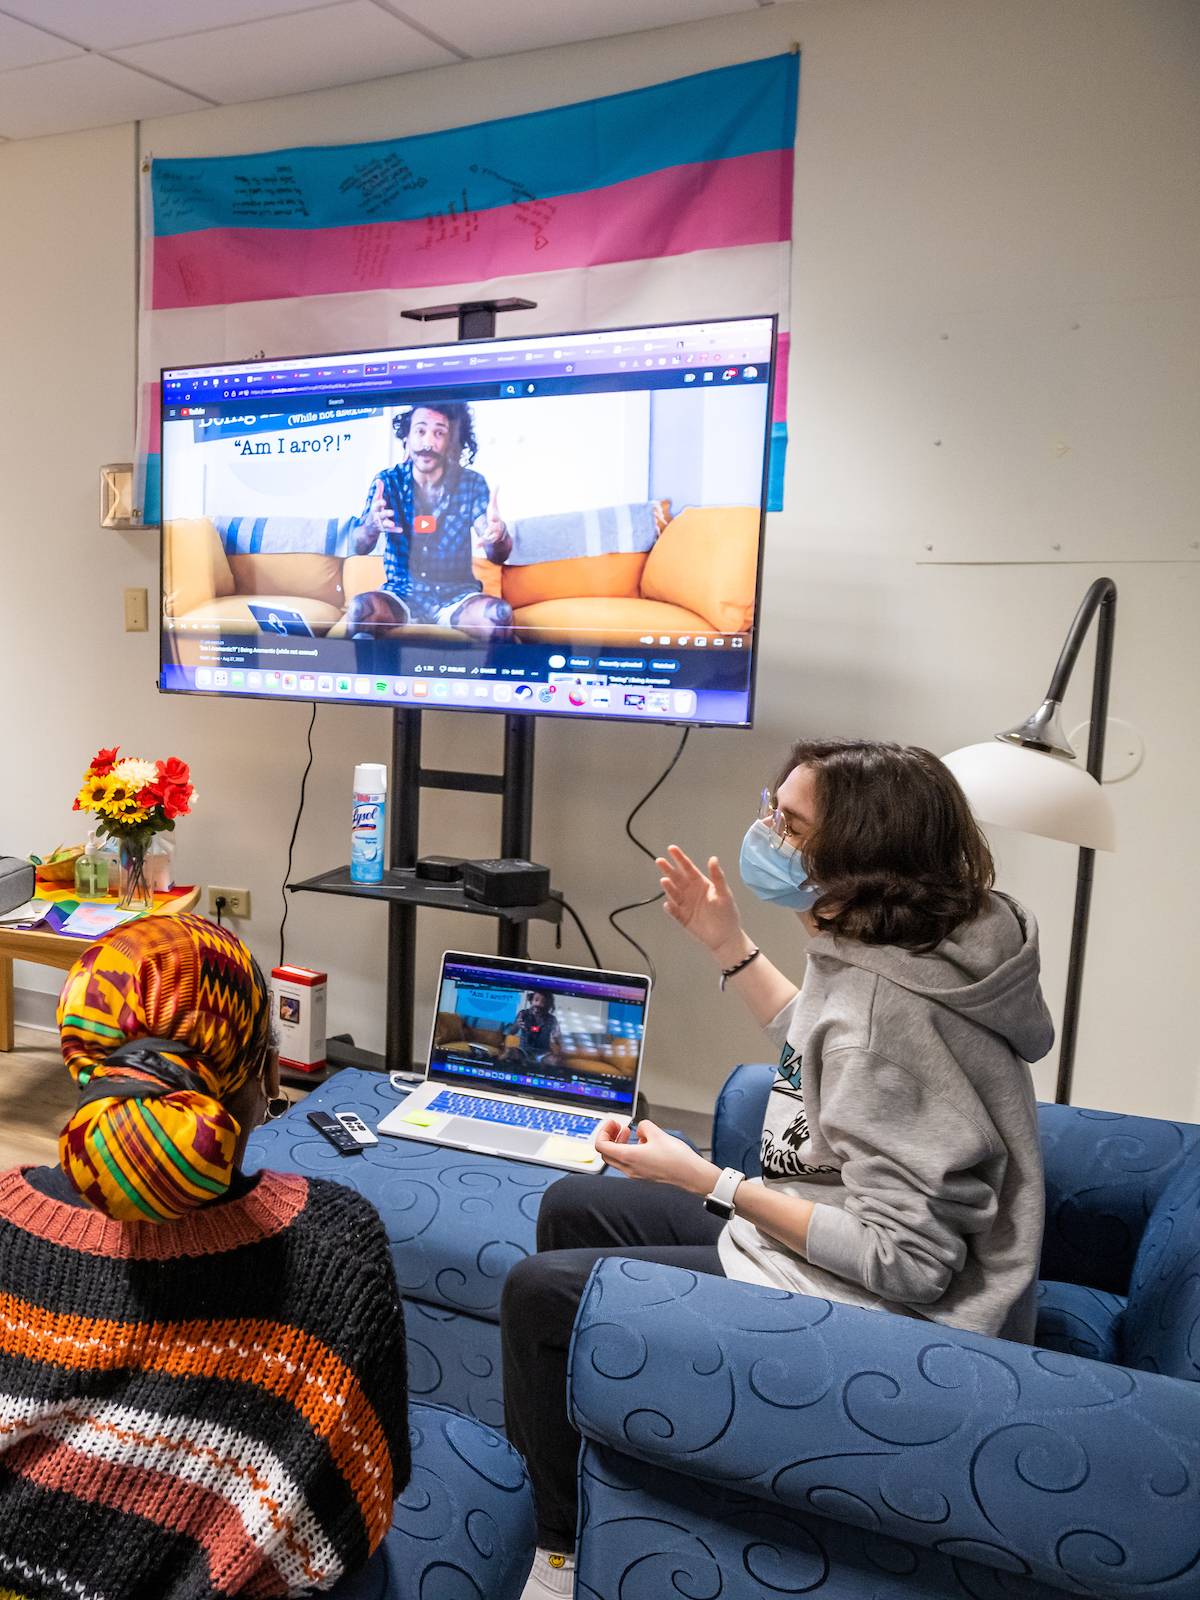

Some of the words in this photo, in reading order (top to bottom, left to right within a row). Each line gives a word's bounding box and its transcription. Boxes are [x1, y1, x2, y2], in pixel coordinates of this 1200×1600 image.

[288, 411, 318, 426] (While
[319, 411, 336, 421] not
[277, 437, 286, 454] I
[353, 807, 378, 827] Lysol
